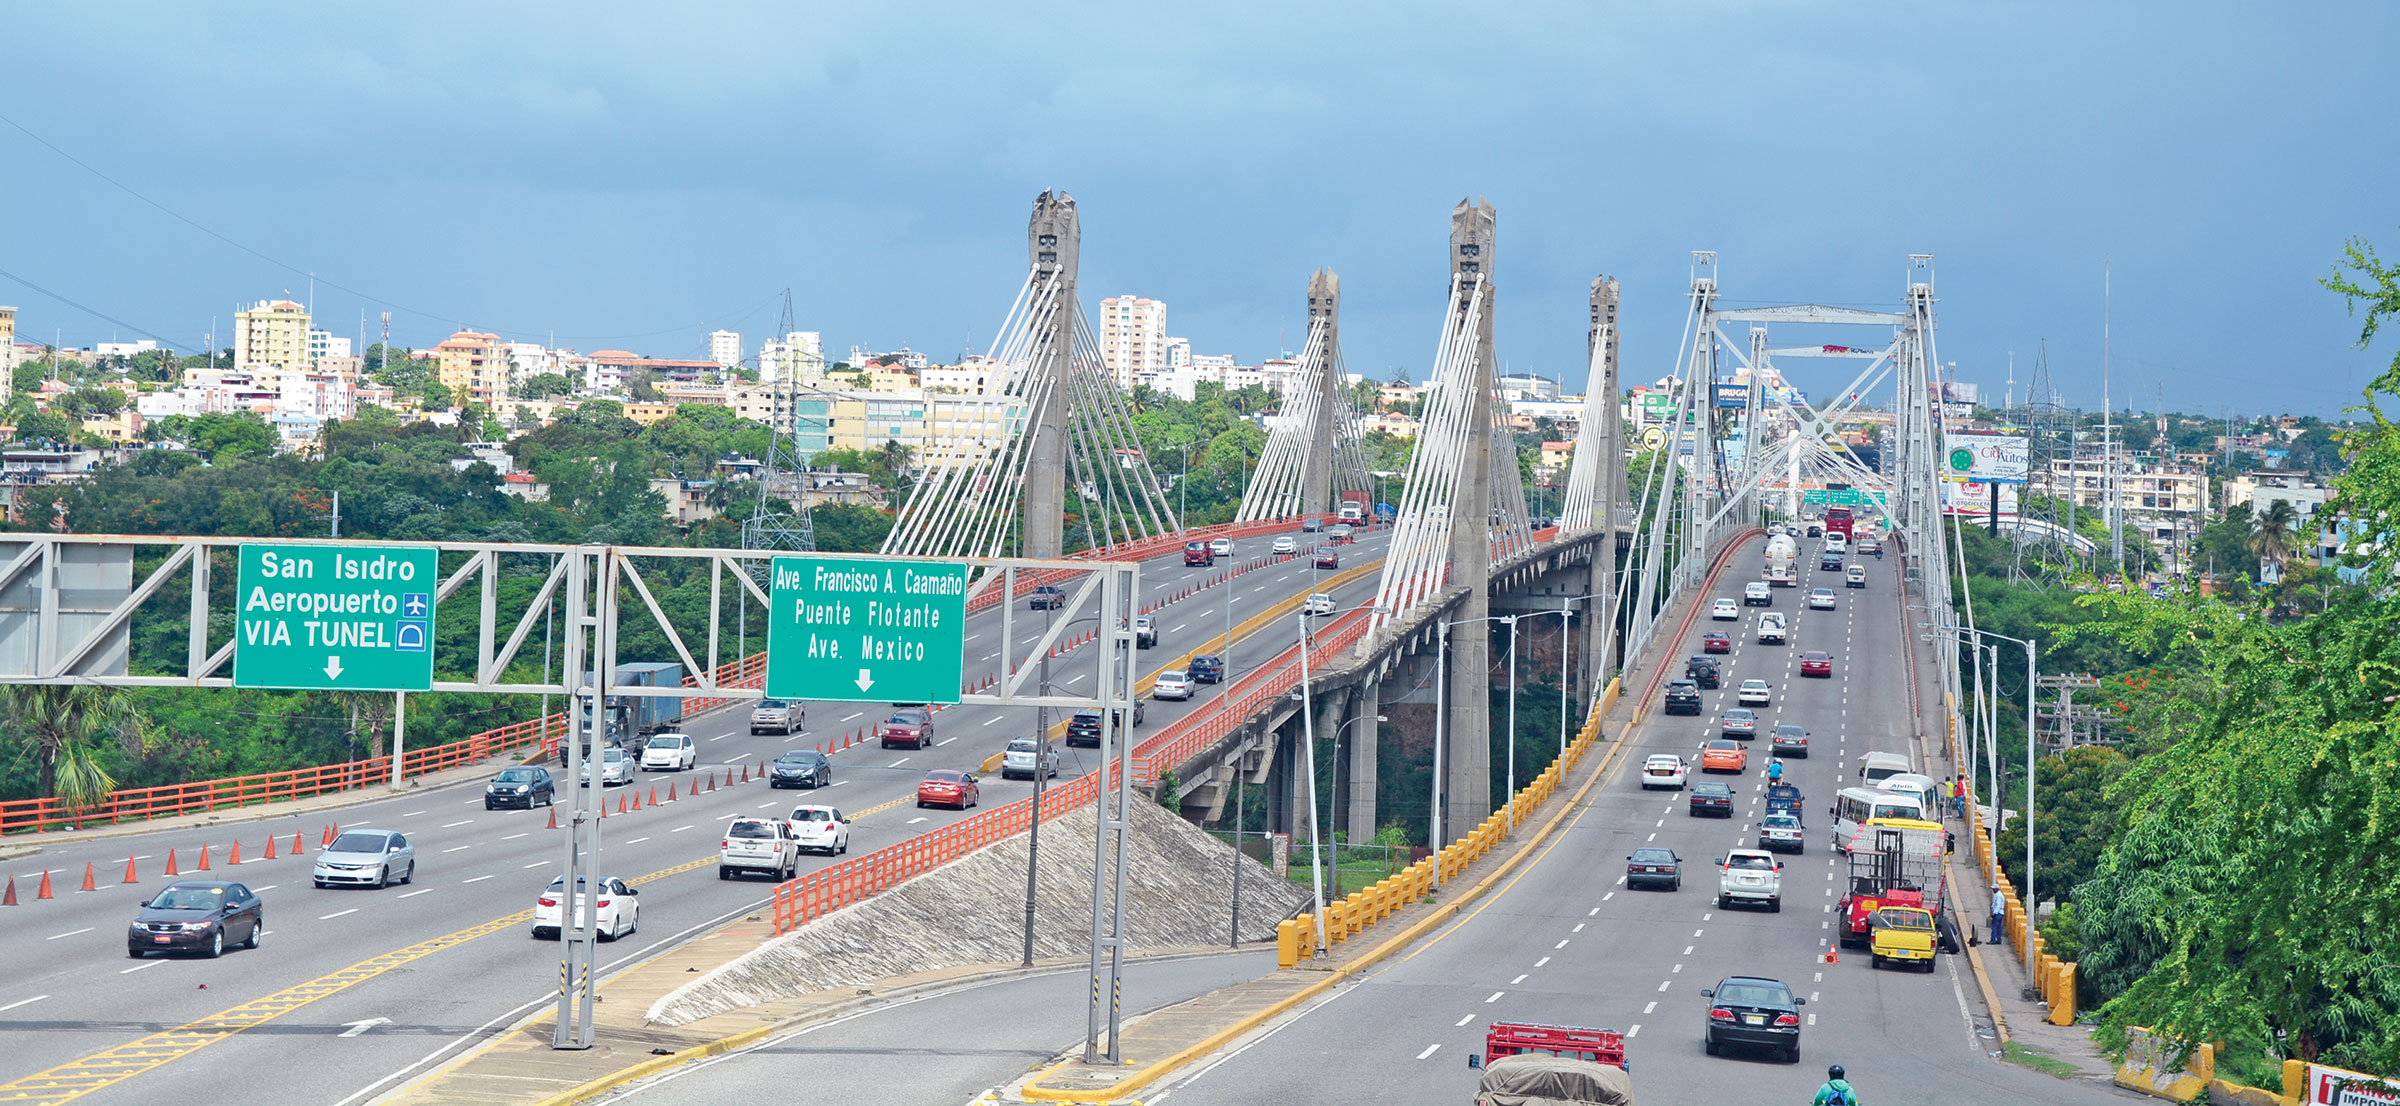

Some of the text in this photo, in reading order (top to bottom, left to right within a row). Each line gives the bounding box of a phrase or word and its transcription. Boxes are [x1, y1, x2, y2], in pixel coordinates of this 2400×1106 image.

[1999, 451, 2028, 464] Autos
[261, 551, 415, 581] San Isidro
[775, 565, 962, 596] Ave. Francisco A. Caamaño
[245, 586, 397, 618] Aeropuerto
[795, 598, 940, 628] Puente Flotante
[244, 619, 391, 648] VIA TUNEL
[808, 633, 924, 662] Ave. Mexico
